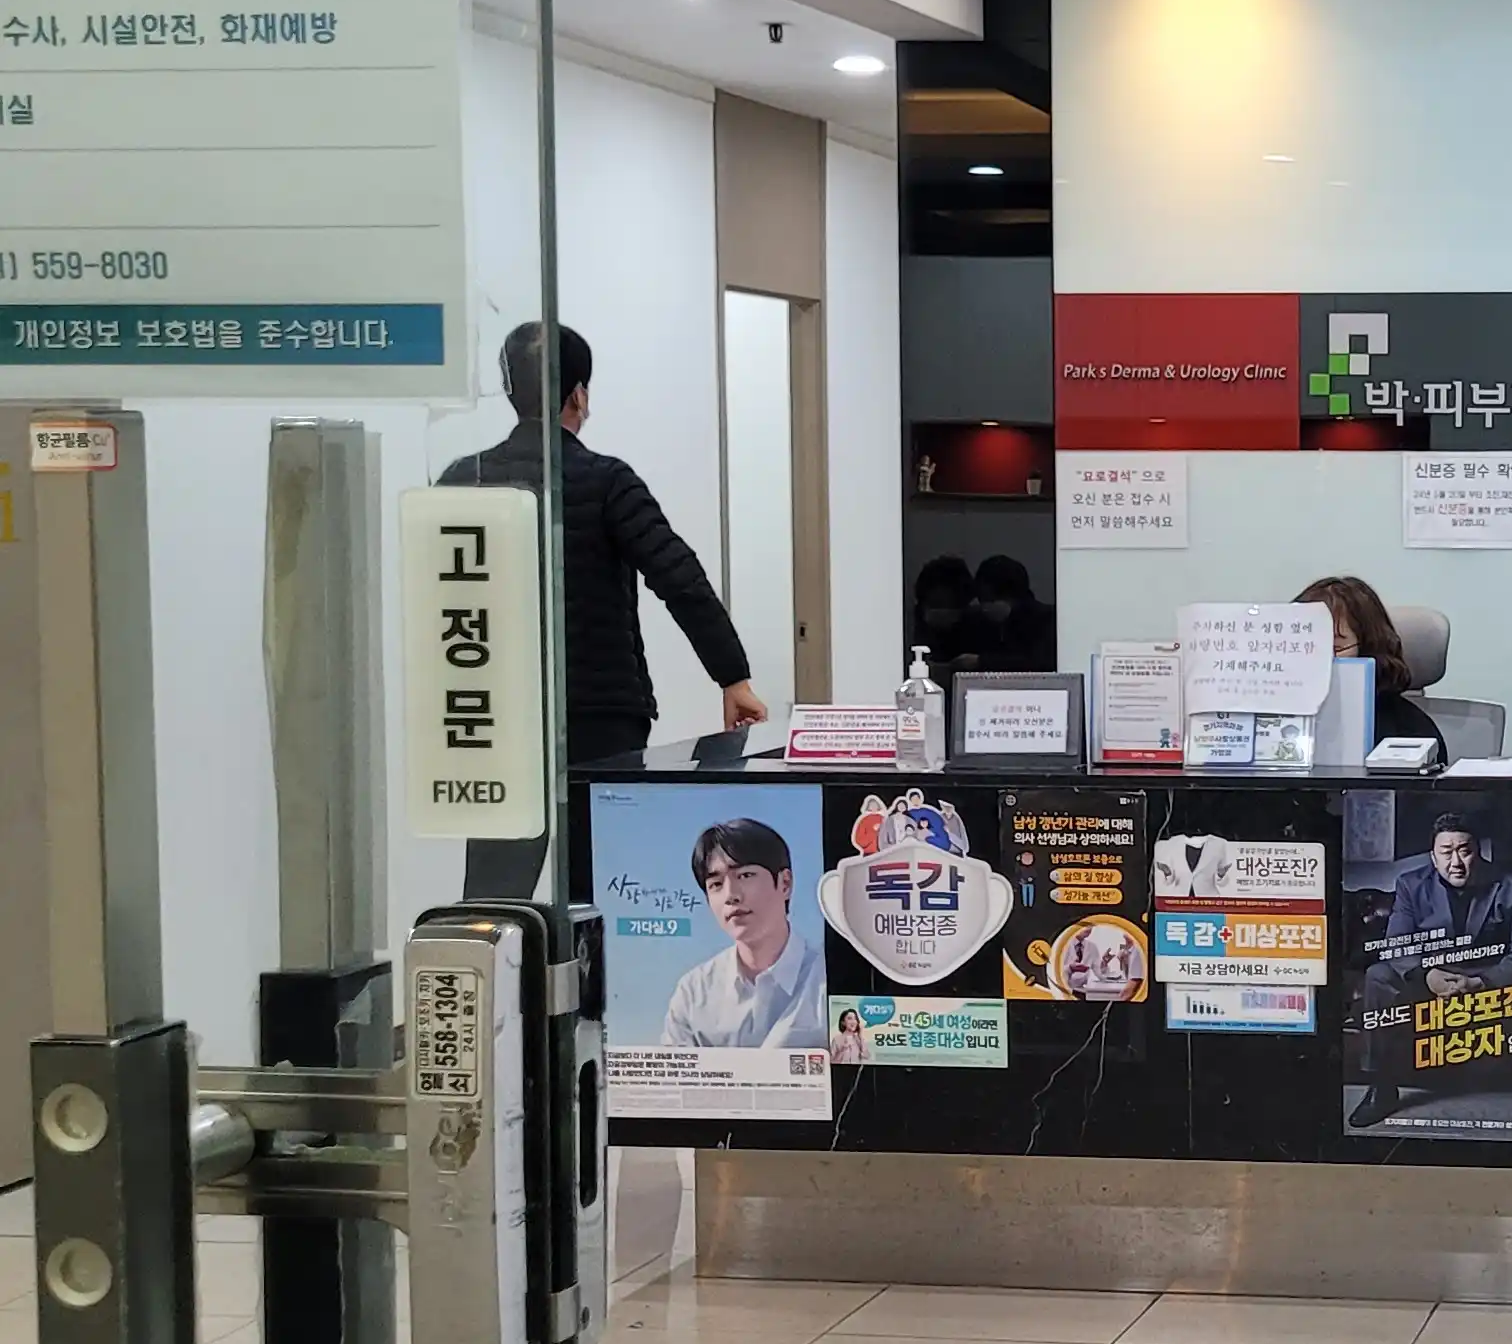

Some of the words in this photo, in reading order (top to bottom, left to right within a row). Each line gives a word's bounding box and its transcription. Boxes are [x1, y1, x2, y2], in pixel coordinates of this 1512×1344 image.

[3, 14, 67, 48] 수사,
[82, 12, 205, 47] 시설안전,
[220, 10, 338, 45] 화재예방
[33, 250, 168, 280] 559-8030
[14, 318, 121, 351] 개인정보
[137, 319, 244, 350] 보호법을
[258, 318, 395, 350] 준수합니다.
[1111, 363, 1160, 379] Derma
[1164, 364, 1175, 379] &
[1180, 363, 1240, 383] Urology
[1243, 363, 1288, 379] Clinic
[36, 432, 89, 449] 항균필름
[1141, 470, 1167, 482] 으로
[1415, 462, 1456, 479] 신분증
[1463, 462, 1490, 480] 필수
[1072, 492, 1096, 506] 오신
[1102, 492, 1125, 506] 분은
[1130, 492, 1155, 507] 접수
[1159, 492, 1171, 507] 시
[1071, 515, 1095, 530] 먼저
[1100, 515, 1174, 530] 말씀해주세요
[438, 525, 495, 749] 고정문
[432, 780, 506, 804] FIXED
[1013, 816, 1037, 830] 남성
[1039, 816, 1073, 830] 갱년기
[1075, 816, 1110, 831] 관리에
[1111, 818, 1133, 831] 대해
[1014, 832, 1035, 845] 의사
[1037, 832, 1078, 846] 선생님과
[1079, 833, 1134, 846] 상의하세요!
[1235, 857, 1319, 878] 대상포진?
[865, 861, 965, 911] 독감
[874, 913, 958, 937] 예방접종
[1165, 921, 1217, 947] 독감
[1234, 923, 1322, 950] 대상포진
[895, 939, 937, 955] 합니다
[1421, 954, 1445, 968] 50세
[1445, 943, 1506, 964] 이상이신가요?
[1178, 962, 1202, 975] 지금
[1204, 963, 1268, 976] 상담하세요!
[434, 973, 459, 1068] 558-1304
[900, 1014, 912, 1028] 만
[915, 1014, 944, 1029] 45세
[946, 1013, 998, 1031] 여성이라면
[1362, 1005, 1412, 1030] 당신도
[874, 1033, 908, 1047] 당신도
[908, 1031, 1001, 1049] 접종대상입니다
